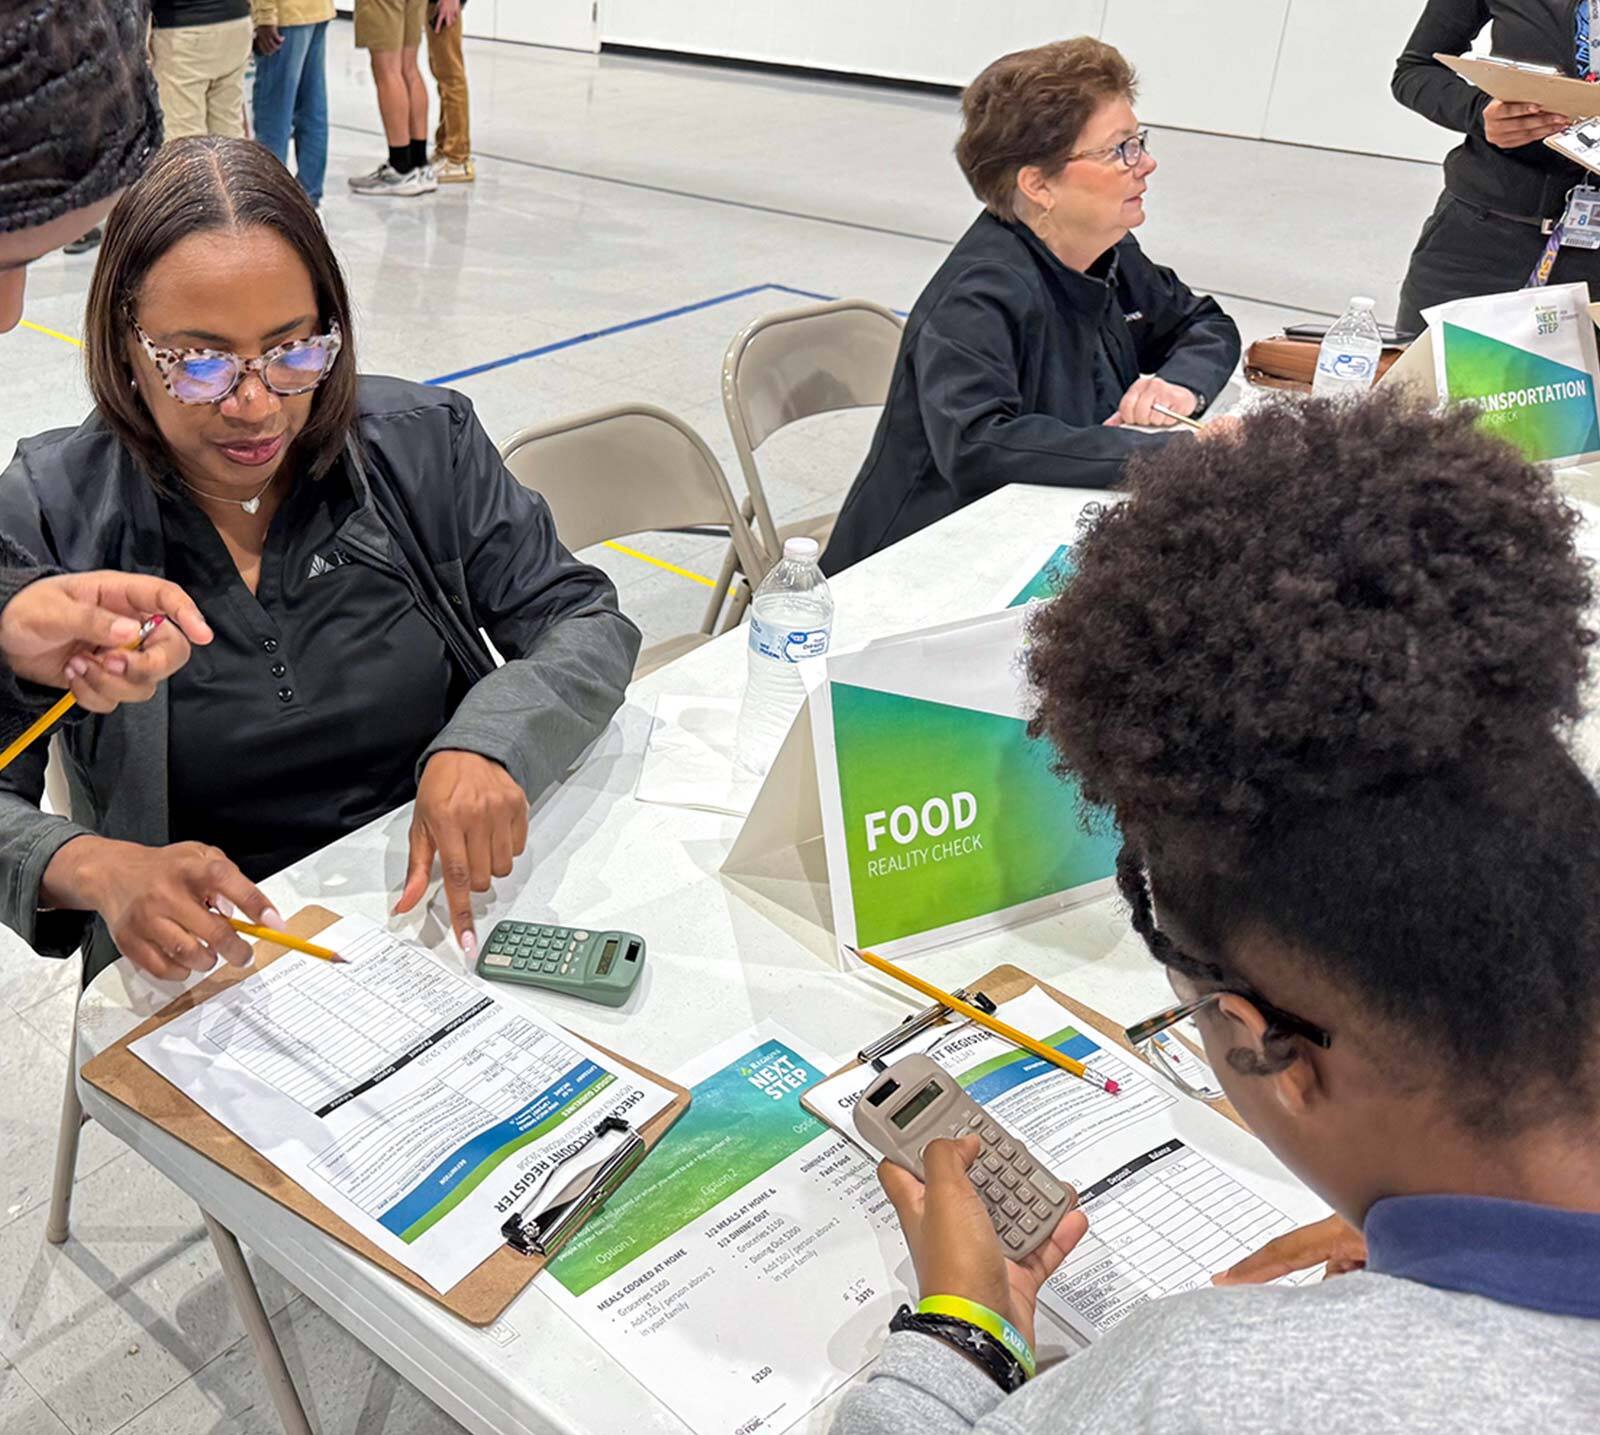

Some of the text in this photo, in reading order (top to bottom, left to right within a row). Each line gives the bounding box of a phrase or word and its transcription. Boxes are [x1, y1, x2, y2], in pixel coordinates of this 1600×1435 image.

[864, 791, 978, 852] FOOD
[868, 834, 984, 877] REALITY CHECK
[747, 1055, 796, 1090] NEXT
[763, 1067, 810, 1101] STEP
[835, 1155, 850, 1168] Food
[494, 1158, 549, 1213] REGISTER
[700, 1173, 733, 1197] Option
[716, 1212, 741, 1230] MEALS
[738, 1205, 751, 1215] AT
[748, 1193, 770, 1209] HOME
[730, 1219, 757, 1239] DINING
[755, 1209, 771, 1222] OUT
[596, 1240, 630, 1265] Option
[736, 1229, 770, 1253] Groceries
[793, 1235, 818, 1253] person
[815, 1222, 834, 1237] above
[750, 1246, 775, 1265] Dining
[781, 1264, 800, 1279] your
[796, 1249, 819, 1266] family
[597, 1248, 688, 1311] MEALS COOKED AT HOME
[1055, 1260, 1112, 1293] TRANSPORTATION
[617, 1292, 653, 1317] Groceries
[630, 1314, 646, 1327] Add
[663, 1286, 690, 1306] person
[687, 1272, 709, 1288] above
[648, 1318, 668, 1334] your
[664, 1301, 691, 1321] family
